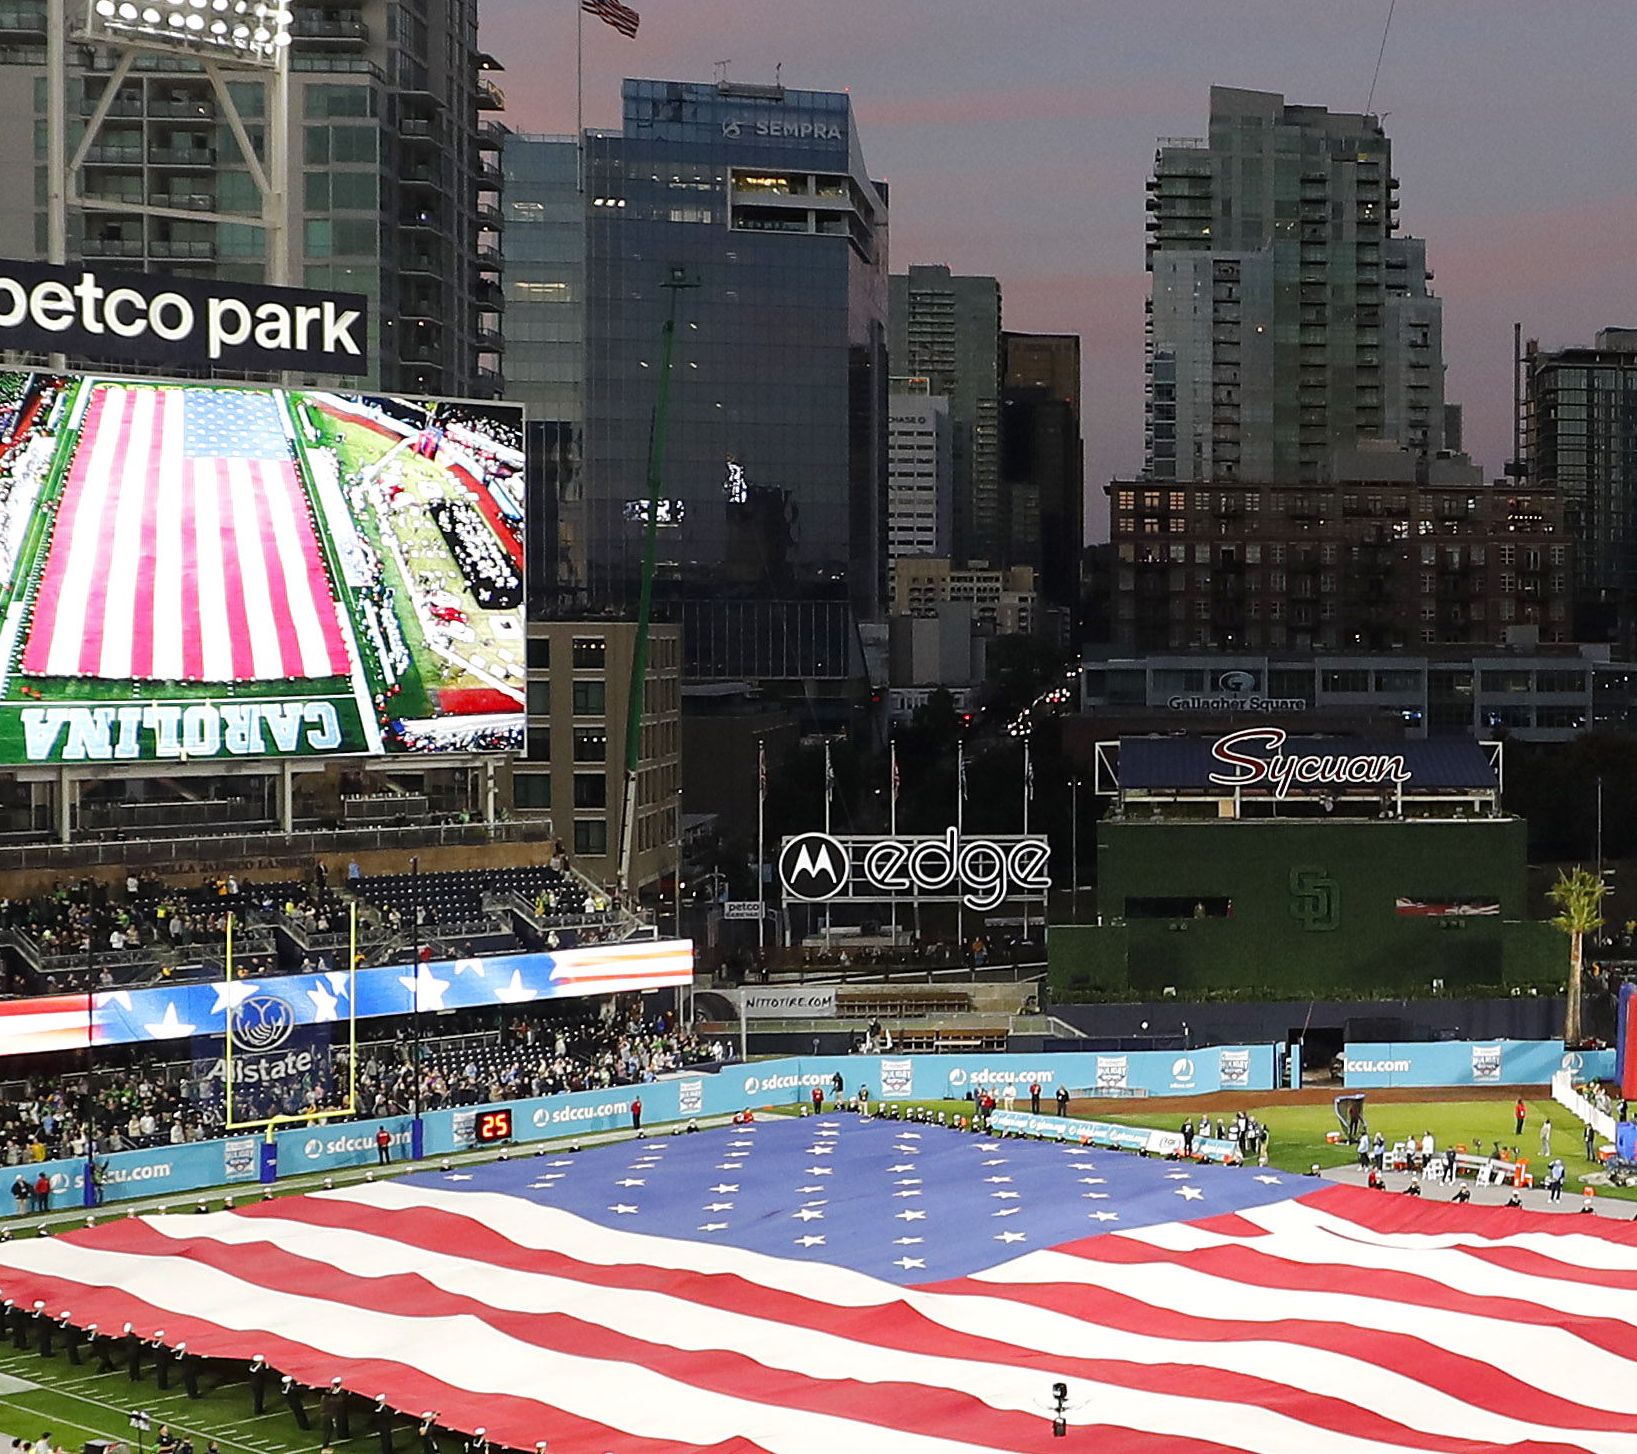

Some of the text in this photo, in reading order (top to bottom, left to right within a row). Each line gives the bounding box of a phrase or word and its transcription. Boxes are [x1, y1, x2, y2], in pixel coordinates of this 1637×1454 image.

[756, 120, 841, 140] SEMPRA
[207, 297, 363, 359] park
[1167, 696, 1306, 712] Gallagher Square
[19, 700, 343, 761] CAROLINA
[1208, 726, 1412, 800] Sycuan
[863, 825, 1052, 912] edge
[728, 903, 760, 913] petco
[745, 994, 832, 1010] NITTOTIRE.COM
[207, 1049, 313, 1085] Allstate
[970, 1068, 1053, 1084] sdccu.com
[552, 1100, 628, 1124] sdccu.com
[481, 1112, 509, 1139] 25
